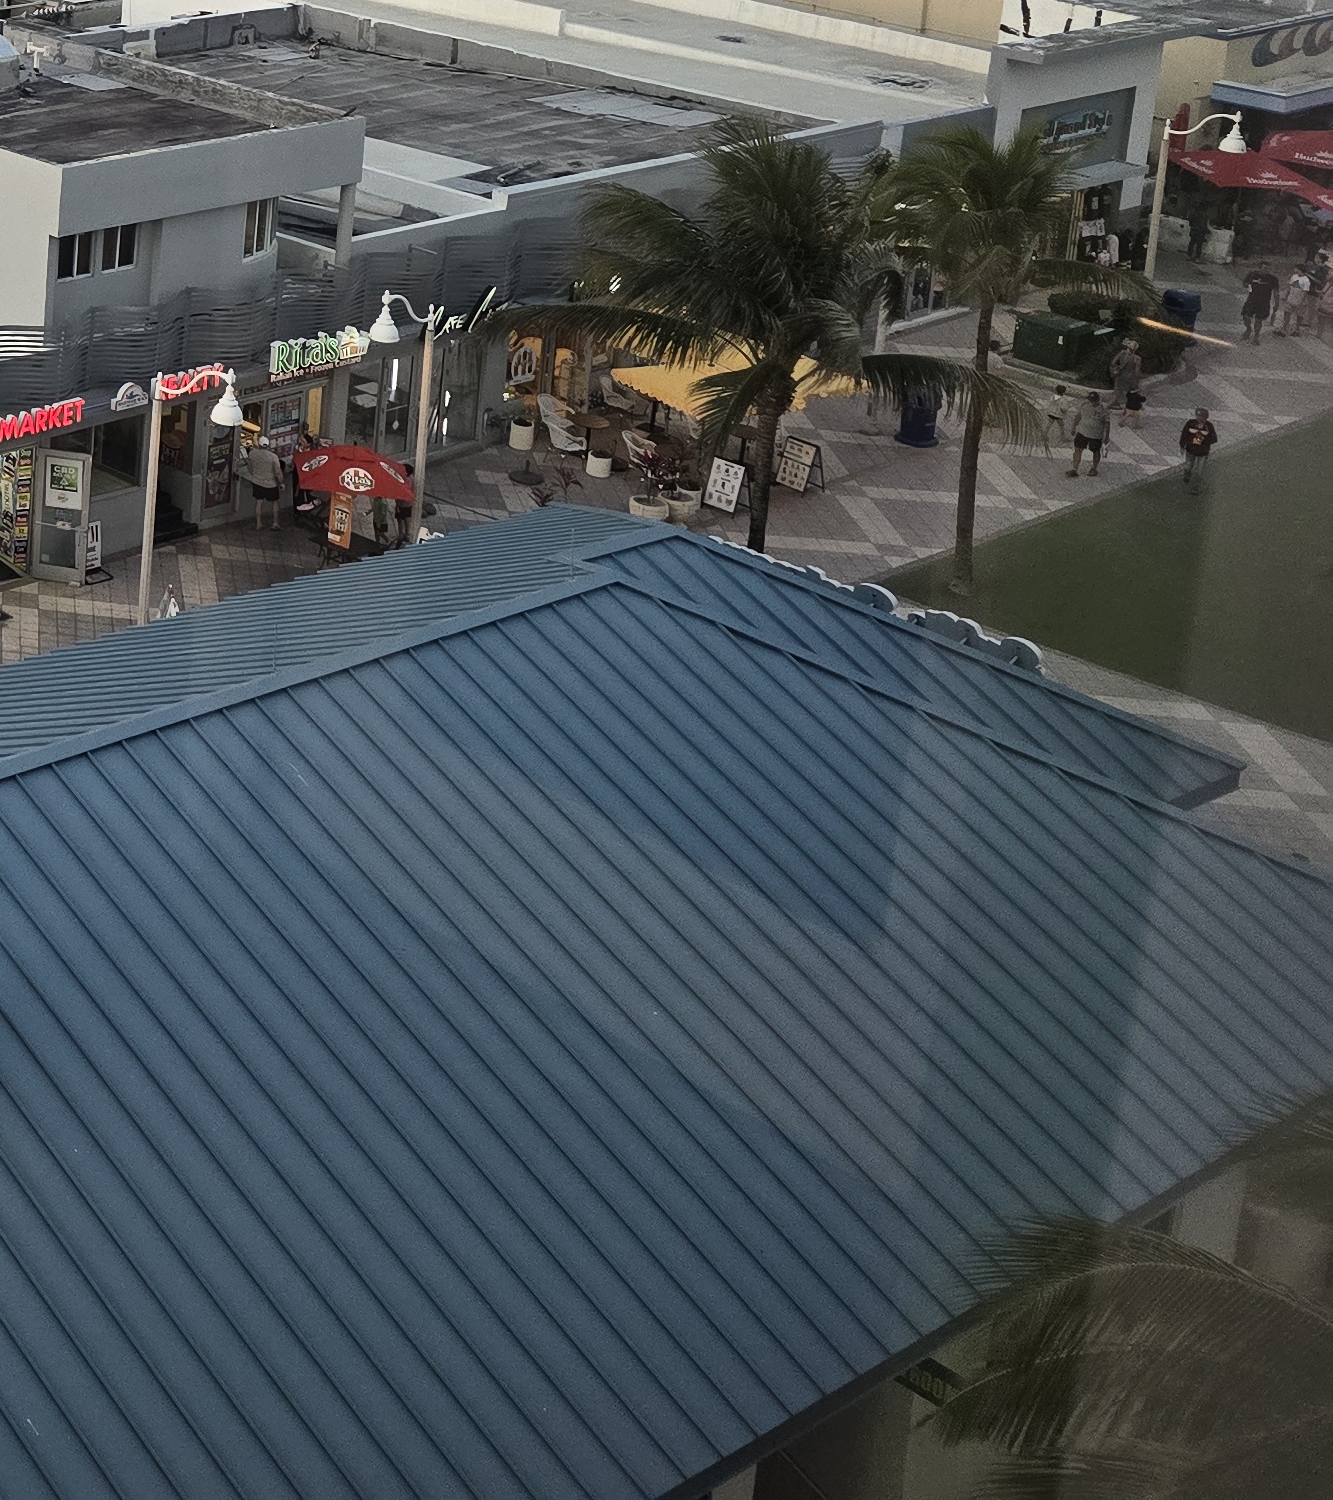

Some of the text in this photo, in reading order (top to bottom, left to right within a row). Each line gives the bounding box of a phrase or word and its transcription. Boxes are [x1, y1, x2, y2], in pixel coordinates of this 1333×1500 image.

[1246, 177, 1301, 187] Budweiser
[275, 335, 340, 375] Rita's
[293, 367, 305, 377] Ice
[310, 361, 334, 374] Frozen
[334, 356, 362, 368] Custard
